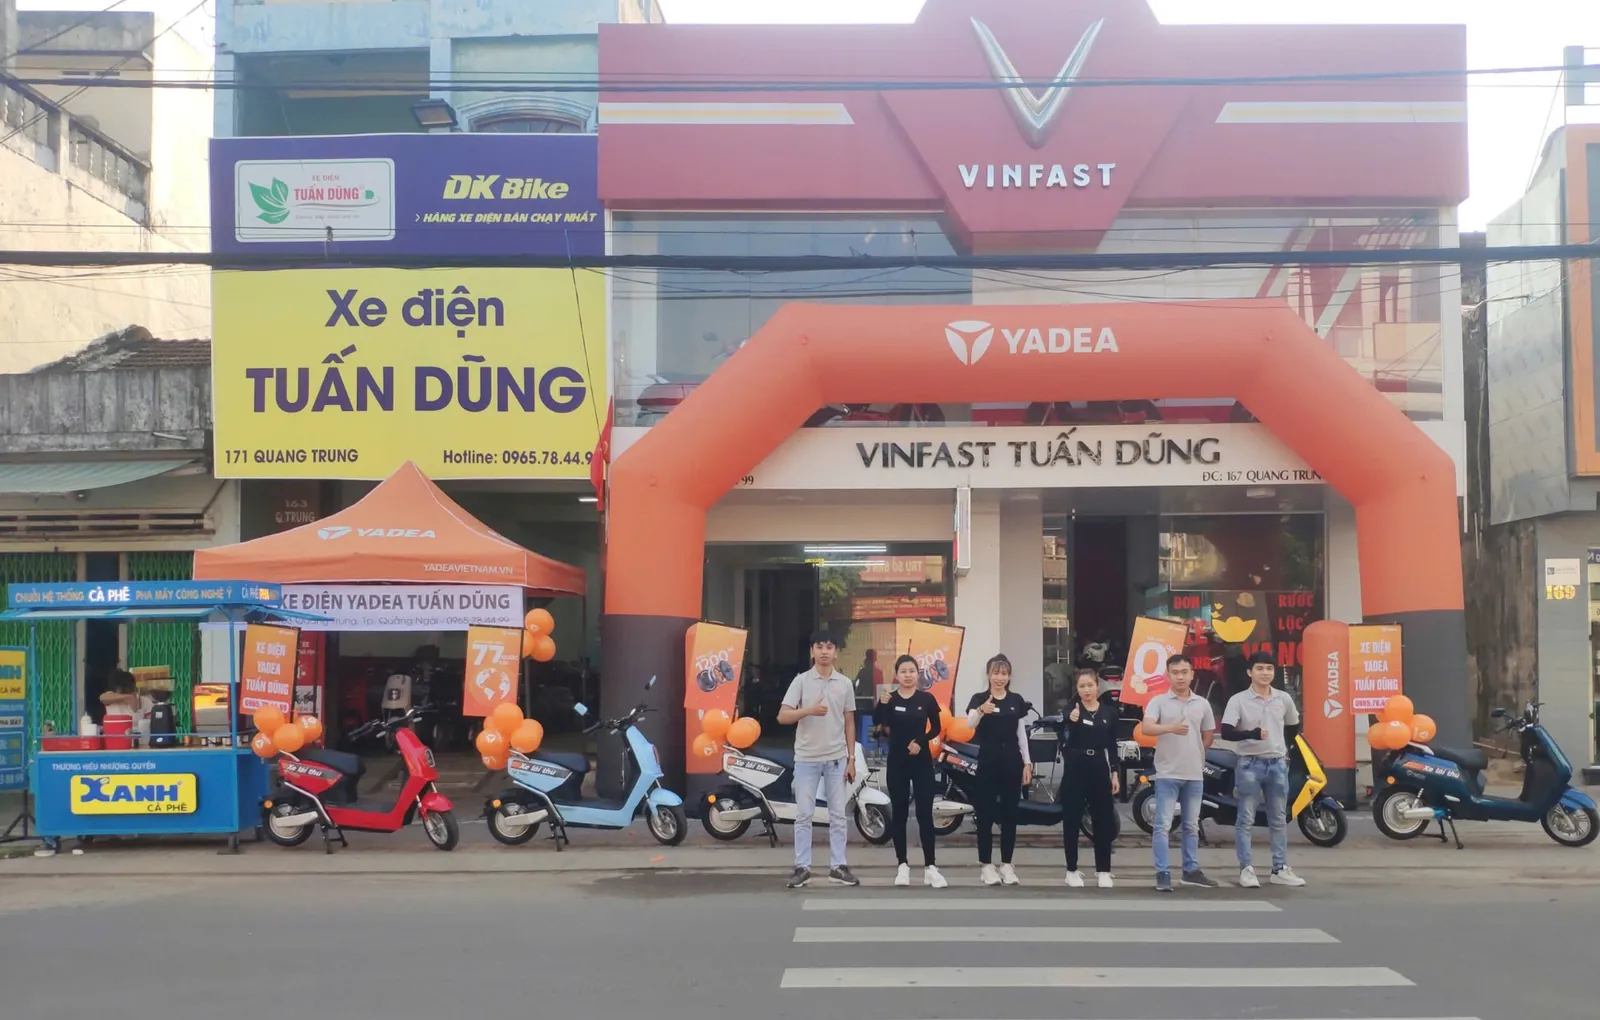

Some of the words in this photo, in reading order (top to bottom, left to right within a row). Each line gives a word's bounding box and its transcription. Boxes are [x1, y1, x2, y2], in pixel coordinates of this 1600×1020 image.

[958, 163, 1116, 188] VINFAST
[442, 174, 501, 200] DK
[500, 178, 570, 200] Bike
[458, 213, 473, 223] XE
[530, 213, 563, 225] CHẠY
[325, 289, 387, 327] Xe
[401, 285, 505, 338] điện
[1001, 327, 1119, 354] YADEA
[246, 344, 394, 413] TUẤN
[414, 354, 587, 414] DŨNG
[856, 441, 995, 468] VINFAST
[1007, 427, 1101, 467] TUẤN
[1115, 432, 1220, 466] DŨNG
[225, 450, 249, 464] 171
[254, 449, 307, 465] QUANG
[311, 448, 359, 464] TRUNG
[443, 450, 498, 464] Hotline:
[502, 450, 594, 466] 0965.78.44.9
[1202, 471, 1222, 481] ĐC:
[1227, 471, 1242, 482] 167
[1246, 470, 1289, 482] QUANG
[1292, 469, 1326, 481] TRUN
[356, 527, 436, 539] YADEA
[423, 563, 513, 575] YADEAVIETNAM.VN
[88, 586, 105, 602] CÀ
[107, 585, 130, 602] PHÊ
[136, 589, 153, 600] PHA
[154, 587, 174, 600] MÁY
[175, 588, 199, 600] CÔNG
[281, 594, 298, 609] XE
[302, 590, 342, 614] ĐIỆN
[347, 594, 402, 609] YADEA
[407, 588, 452, 609] TUẤN
[459, 590, 510, 609] DŨNG
[1545, 585, 1576, 600] 169
[472, 644, 505, 666] 77
[1360, 642, 1371, 653] XE
[1327, 651, 1340, 696] YADEA
[1364, 660, 1388, 672] YADEA
[1423, 764, 1434, 772] Xe
[80, 776, 178, 803] XANH
[147, 803, 161, 812] CÀ
[166, 802, 188, 812] PHÊ
